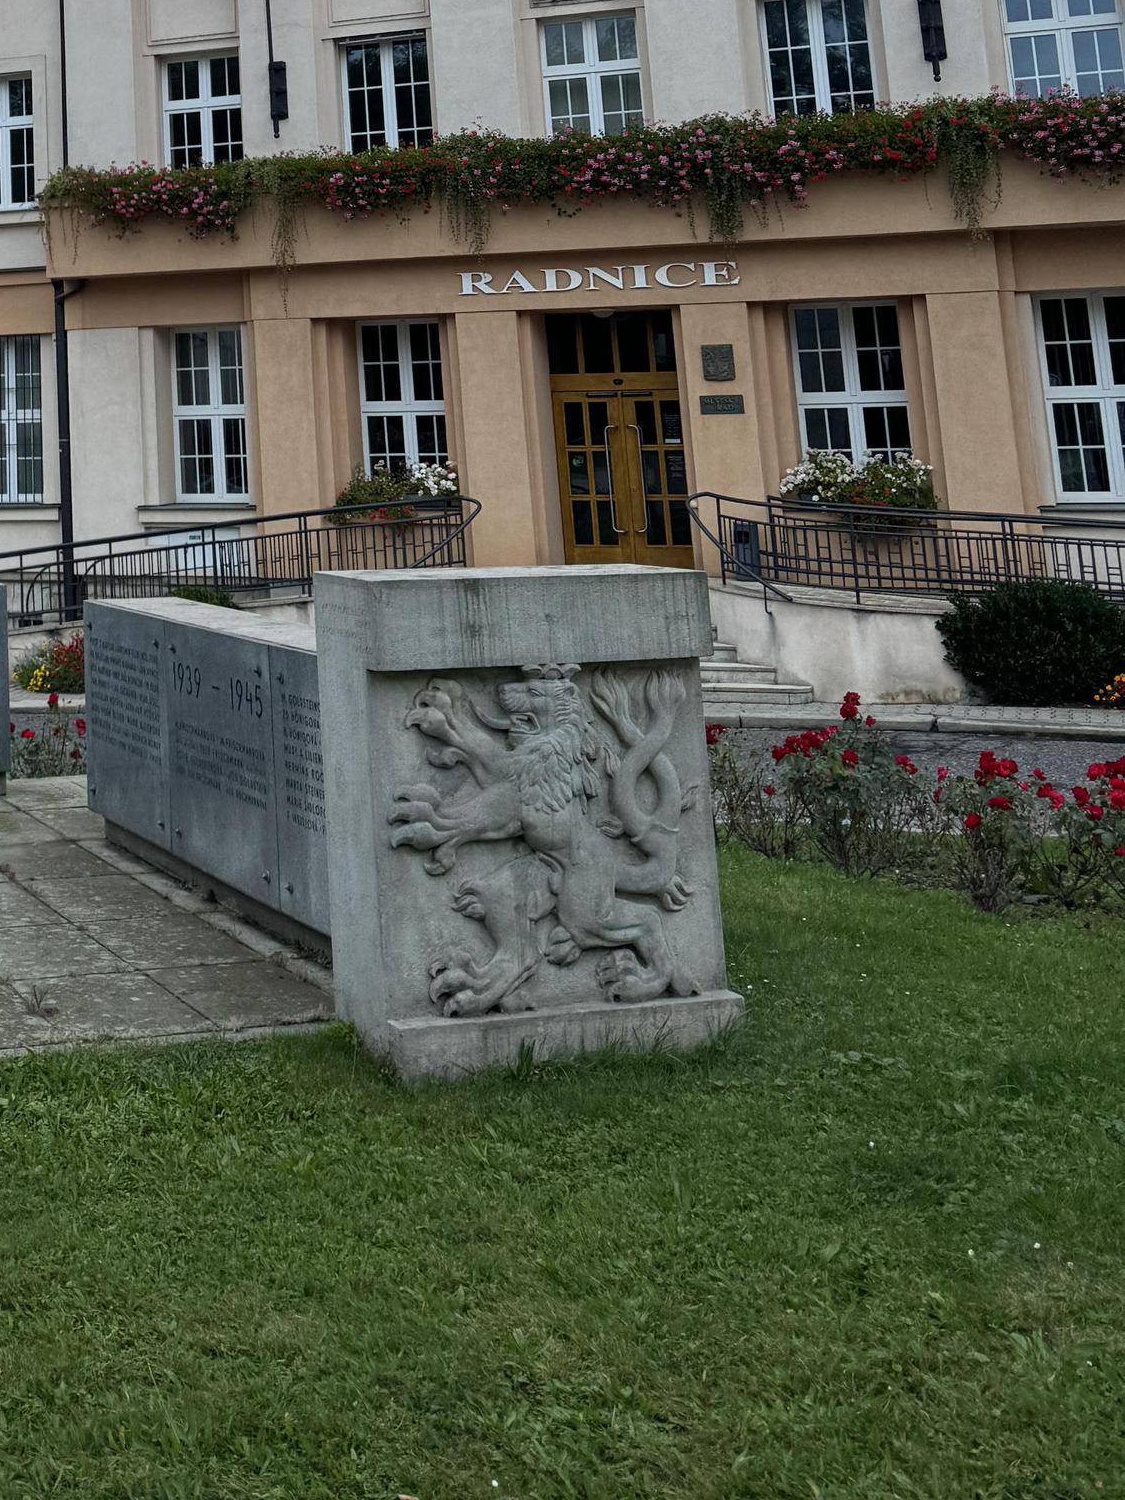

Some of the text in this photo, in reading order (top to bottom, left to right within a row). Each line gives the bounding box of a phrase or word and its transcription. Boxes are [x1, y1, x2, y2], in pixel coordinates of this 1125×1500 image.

[456, 261, 741, 295] RADNICE
[173, 661, 201, 698] 1939
[230, 677, 263, 718] 1945
